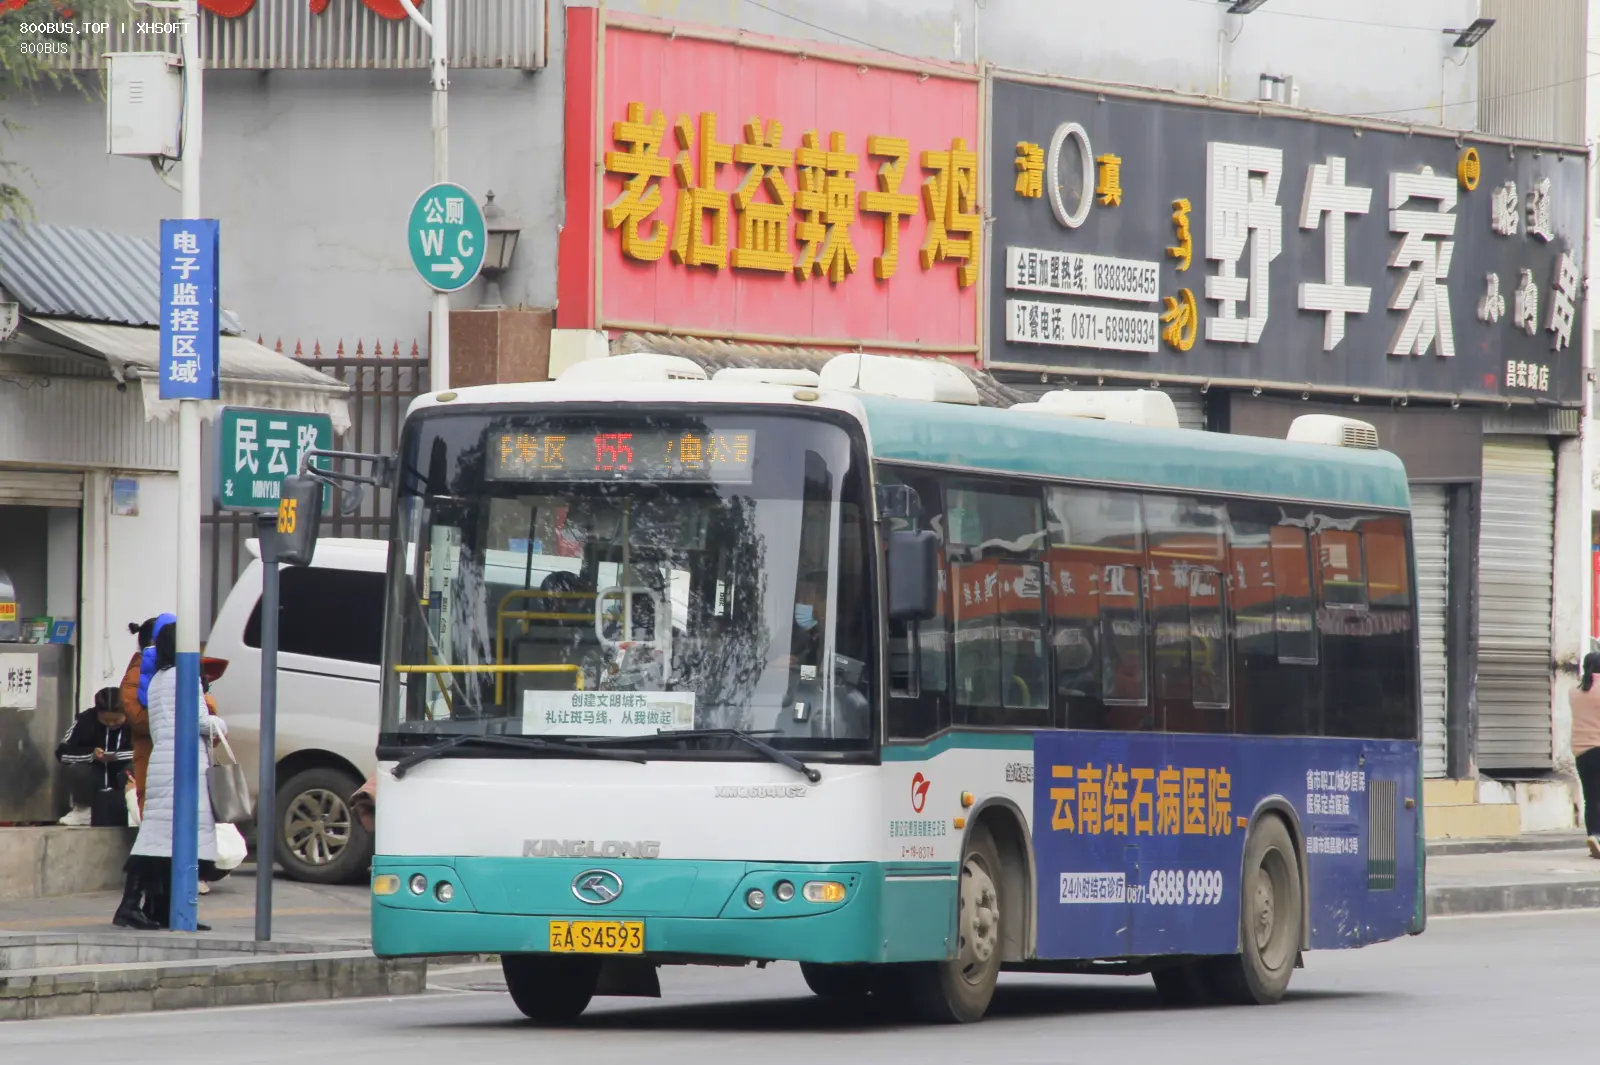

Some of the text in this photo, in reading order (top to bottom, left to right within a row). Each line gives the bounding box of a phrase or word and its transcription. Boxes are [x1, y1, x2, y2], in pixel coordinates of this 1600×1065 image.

[424, 197, 464, 224] 公厕
[604, 102, 979, 287] 老沾益辣子鸡
[1205, 142, 1457, 356] 野牛家
[169, 230, 200, 384] 电子监控区域
[1506, 360, 1549, 392] 昌宏路店
[235, 418, 318, 475] 民云路
[594, 433, 633, 471] 155
[225, 479, 234, 497] 北
[571, 693, 648, 708] 创建文明城市
[545, 710, 672, 725] 礼让斑马线，从我做起
[1050, 762, 1232, 837] 云南结石病医院
[1306, 794, 1350, 816] 医保定点医院
[1062, 876, 1124, 900] 24小时结石诊疗
